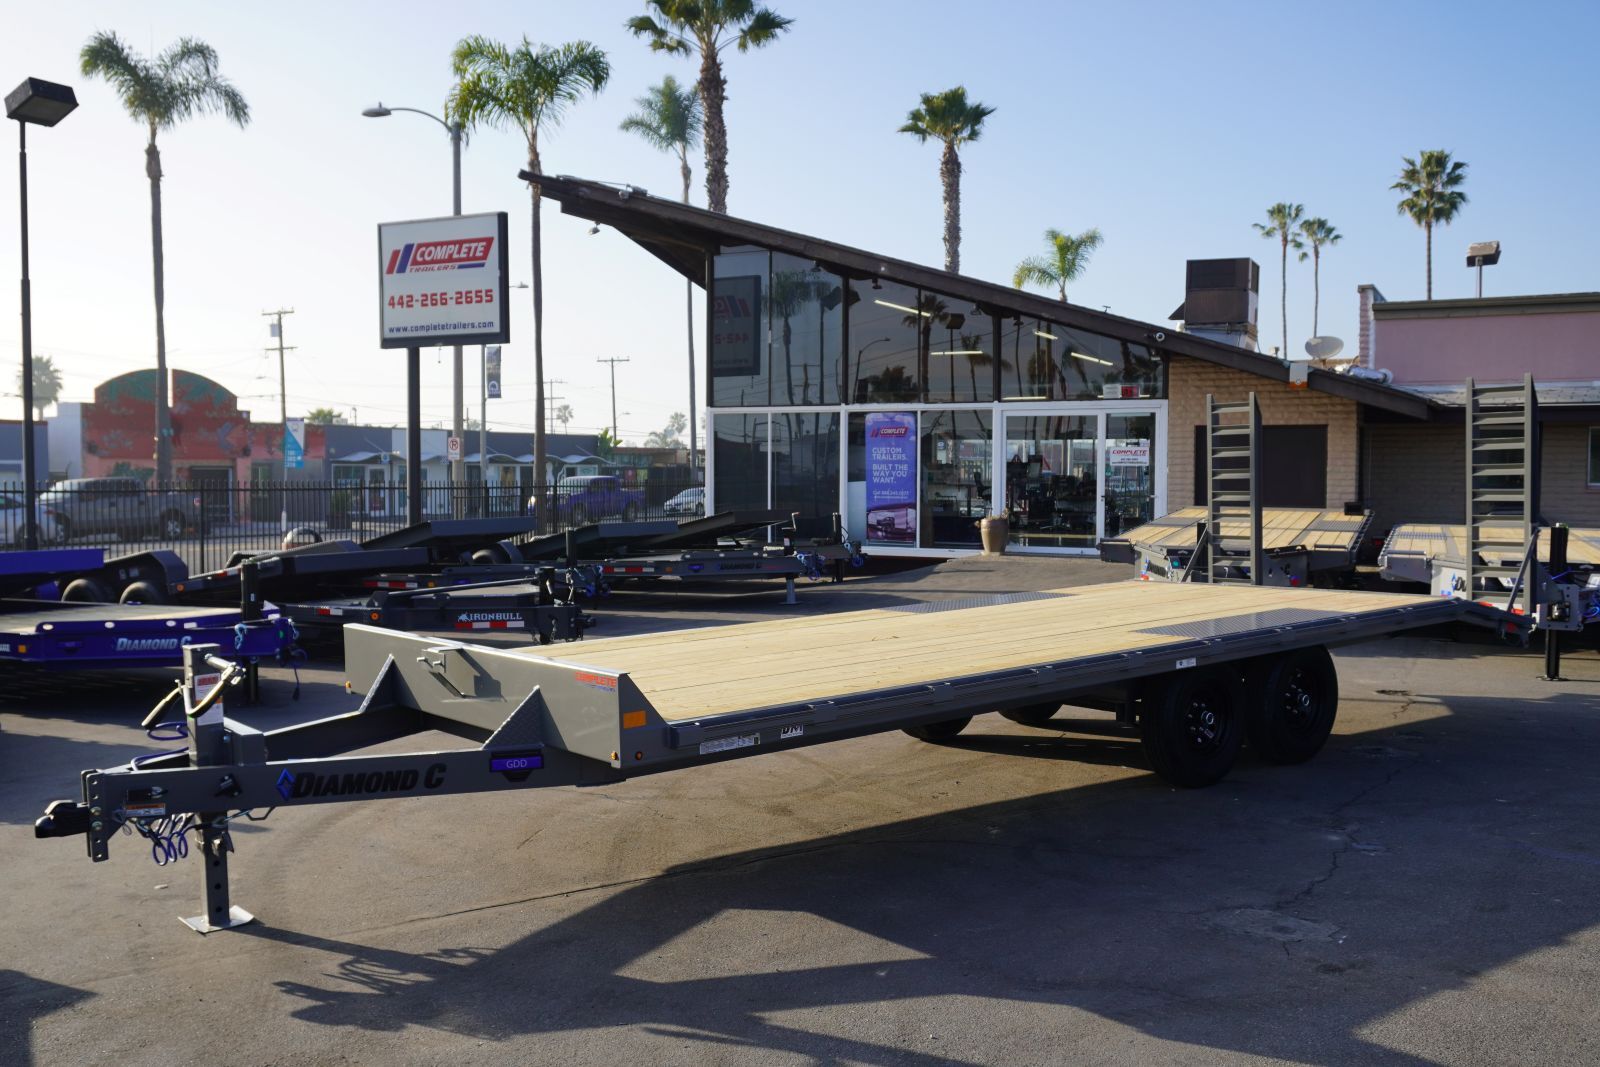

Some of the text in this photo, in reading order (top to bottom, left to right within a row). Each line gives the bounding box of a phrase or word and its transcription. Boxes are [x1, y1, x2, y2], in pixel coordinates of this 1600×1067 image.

[415, 242, 486, 262] COMPLETE
[409, 264, 456, 273] TRAILERS
[388, 288, 494, 309] 442-266-2655
[388, 321, 494, 333] www.completetrailers.com
[470, 612, 522, 621] IRONBULL
[116, 637, 177, 651] DIAMOND
[506, 759, 527, 769] GDD
[292, 763, 447, 798] DIAMOND C
